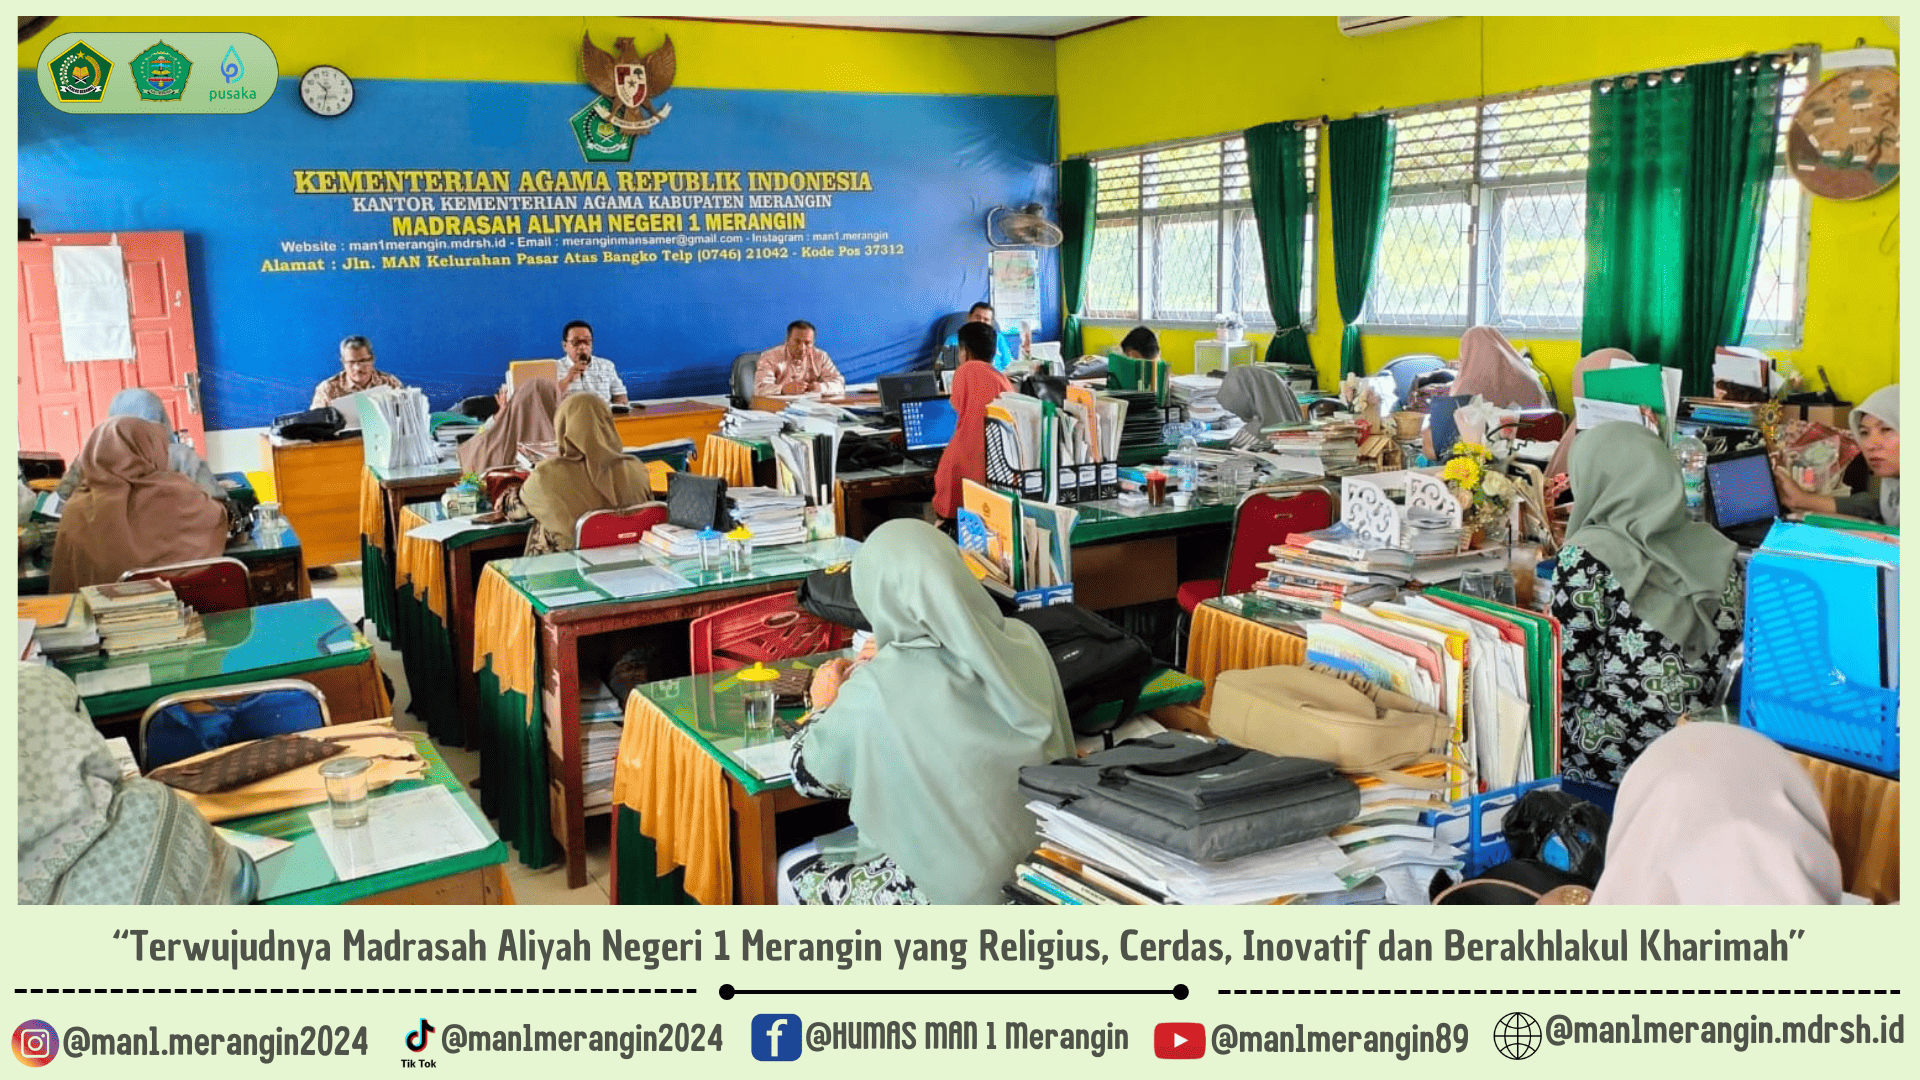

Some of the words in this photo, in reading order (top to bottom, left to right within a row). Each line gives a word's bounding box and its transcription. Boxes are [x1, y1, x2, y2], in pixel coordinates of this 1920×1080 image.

[294, 170, 511, 194] KEMENTERIAN
[518, 170, 612, 193] AGAMA
[616, 170, 742, 193] REPUBLIK
[747, 170, 874, 192] INDONESIA
[352, 197, 435, 212] KANTOR
[441, 196, 578, 211] KEMENTERIAN
[583, 196, 644, 210] AGAMA
[649, 195, 744, 209] KABUPATEN
[749, 195, 833, 209] MERANGIN
[392, 215, 522, 236] MADRASAH
[528, 214, 603, 234] ALIYAH
[608, 213, 684, 233] NEGERI
[688, 213, 701, 231] 1
[705, 212, 806, 231] MERANGIN
[281, 241, 337, 252] Website
[349, 238, 506, 252] man1merangin.mdrsh.id
[518, 237, 551, 248] Email
[562, 234, 743, 248] meranginmansamer@gmail.com
[752, 233, 804, 245] Instagram
[812, 231, 889, 243] man1.merangin
[261, 258, 325, 273] Alamat
[342, 258, 376, 270] Jln.
[382, 256, 421, 269] MAN
[426, 254, 512, 268] Kelurahan
[516, 252, 560, 266] Pasar
[564, 252, 598, 264] Atas
[602, 250, 658, 266] Bangko
[661, 249, 693, 264] Telp
[697, 248, 742, 263] (0746)
[745, 247, 789, 260] 21042
[802, 246, 835, 258] Kode
[838, 246, 861, 258] Pos
[864, 244, 905, 256] 37312
